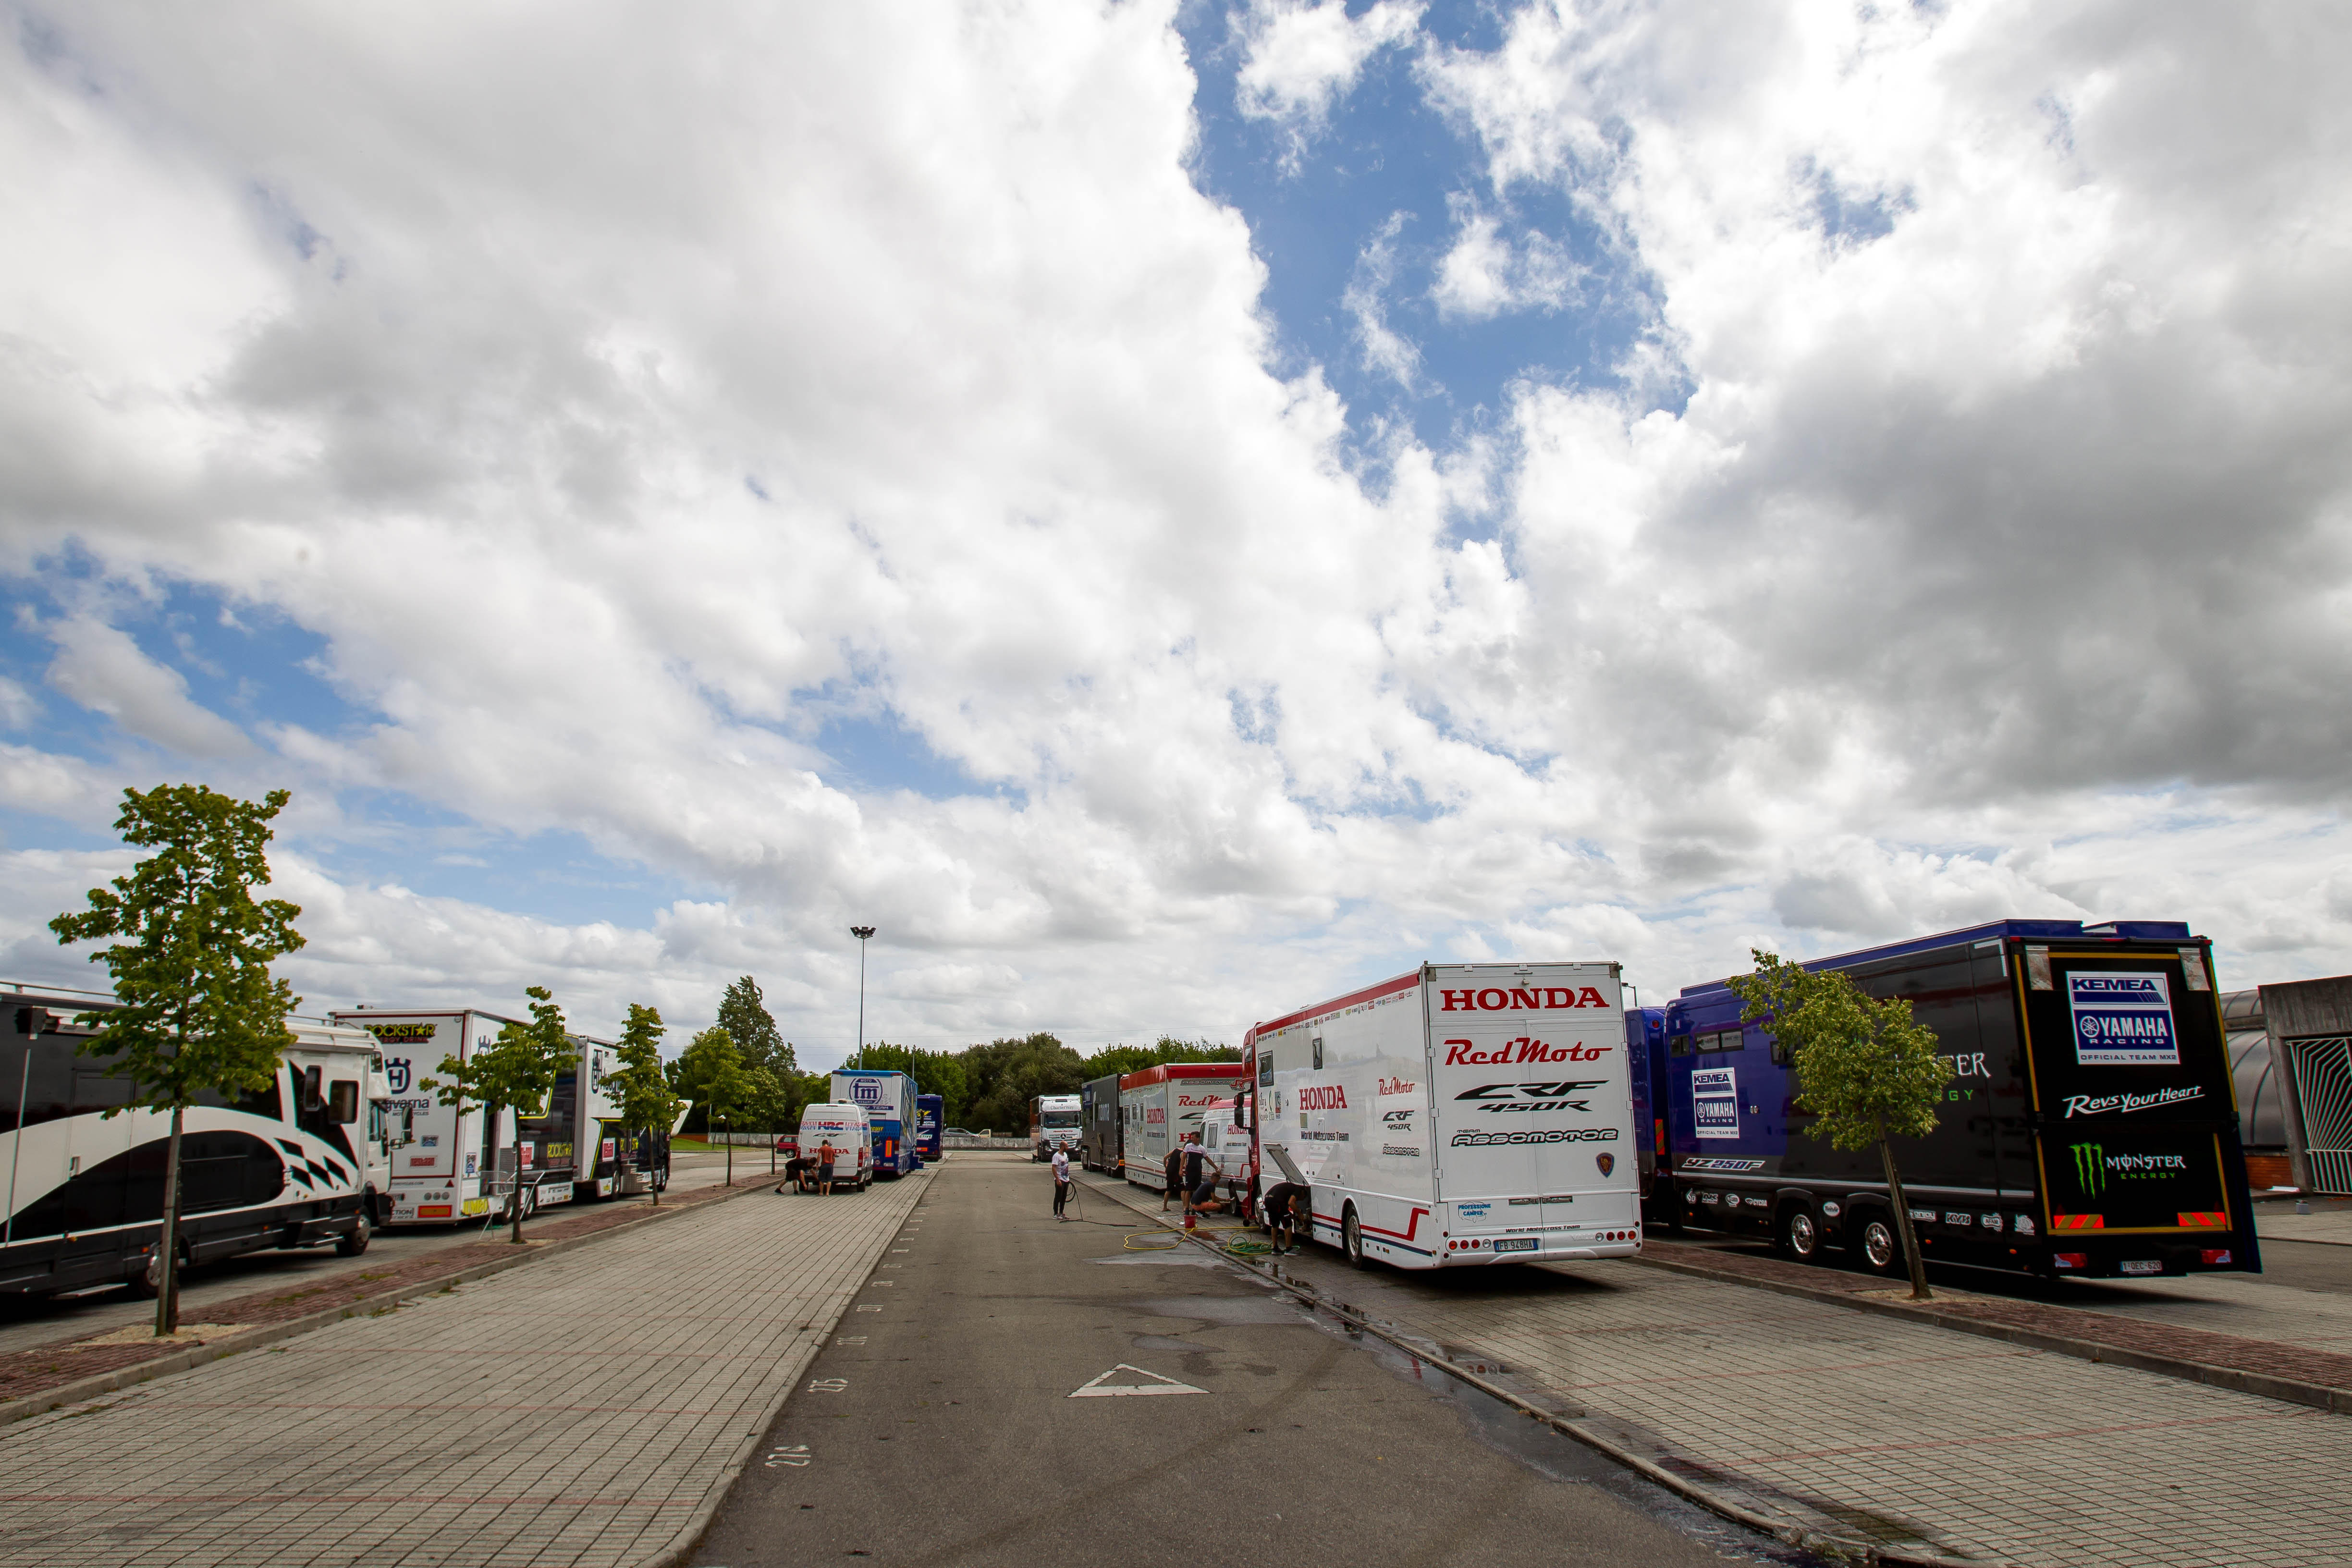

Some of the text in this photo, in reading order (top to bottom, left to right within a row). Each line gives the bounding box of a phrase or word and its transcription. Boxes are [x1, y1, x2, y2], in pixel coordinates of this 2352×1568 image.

[2071, 979, 2157, 991] KEMEA
[1440, 987, 1610, 1011] HONDA
[2098, 1017, 2168, 1037] YAMAHA
[1443, 1037, 1613, 1066] RedMoto
[1693, 1073, 1730, 1084] KEMEA
[1378, 1077, 1415, 1096] RedMoto
[1454, 1079, 1610, 1100] CRF
[1299, 1085, 1348, 1111] HONDA
[2062, 1085, 2202, 1118] Revs Your Heart
[1477, 1100, 1594, 1113] 450R
[1704, 1102, 1735, 1117] YAMAHA
[1147, 1107, 1165, 1124] HONDA
[1382, 1110, 1415, 1122] CRF
[818, 1121, 845, 1130] HRC
[1387, 1123, 1411, 1131] 450R
[1300, 1131, 1349, 1141] World Motocross Team
[1451, 1128, 1619, 1147] ASSOMOTOR
[1383, 1146, 1420, 1157] ASSOMOTOR
[1682, 1157, 1766, 1171] YZ250F
[1946, 1213, 1970, 1225] KYB
[1499, 1239, 1533, 1250] FB 948HA
